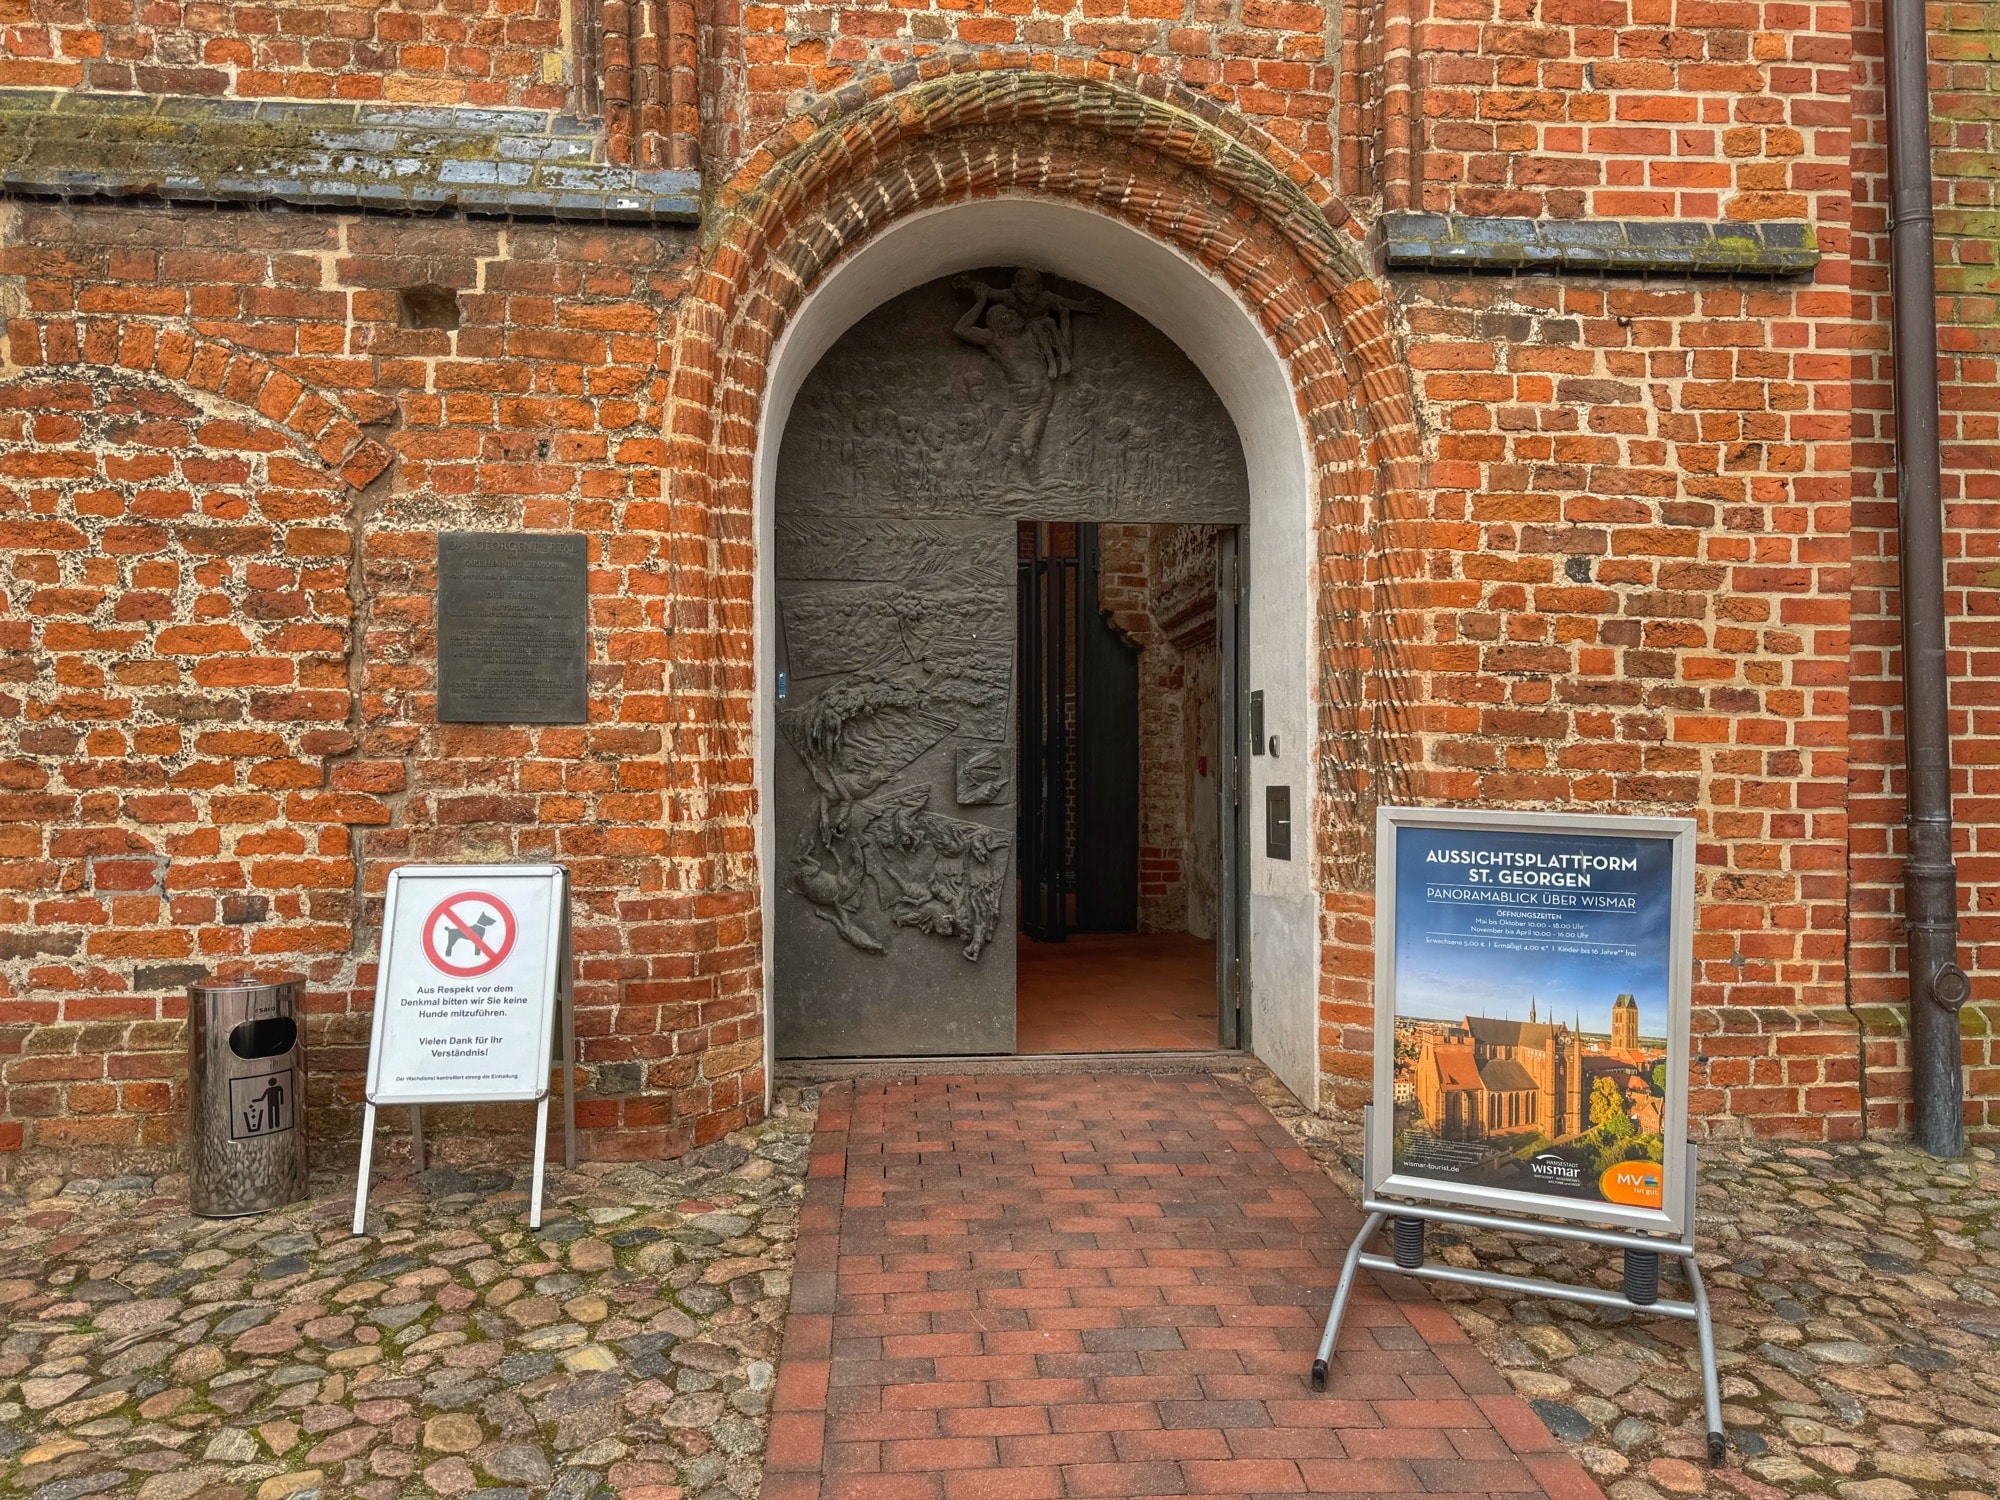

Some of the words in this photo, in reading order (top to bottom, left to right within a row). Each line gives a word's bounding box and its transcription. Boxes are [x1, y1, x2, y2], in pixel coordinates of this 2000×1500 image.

[447, 540, 470, 551] DAS
[476, 540, 577, 554] GEORGENPORTAL
[485, 560, 523, 569] HENNING
[1425, 849, 1637, 872] AUSSICHTSPLATTFORM
[1468, 868, 1493, 883] ST.
[1498, 869, 1591, 888] GEORGEN
[1427, 887, 1538, 904] PANORAMABLICK
[1542, 891, 1577, 906] ÜBER
[1581, 896, 1636, 909] WISMAR
[1496, 909, 1562, 920] ÖFFNUNGSZEITEN
[1475, 917, 1487, 925] Mai
[1499, 919, 1526, 927] Oktober
[1552, 922, 1571, 930] 18.00
[1470, 925, 1503, 934] November
[1516, 929, 1531, 937] April
[1425, 936, 1462, 946] Erwachsene
[1493, 941, 1522, 951] Ermäßigt
[1557, 945, 1579, 953] Kinder
[1580, 947, 1590, 955] bis
[416, 986, 435, 994] Aus
[437, 985, 474, 995] Respekt
[493, 985, 514, 993] dem
[400, 998, 440, 1007] Denkmal
[442, 998, 468, 1006] bitten
[487, 997, 502, 1005] Sie
[503, 996, 528, 1004] keine
[418, 1009, 448, 1018] Hunde
[450, 1009, 507, 1018] mitzuführen.
[418, 1037, 447, 1046] Vielen
[449, 1036, 473, 1045] Dank
[475, 1036, 489, 1045] für
[490, 1035, 503, 1044] Ihr
[431, 1048, 489, 1058] Verständnis!
[1403, 1161, 1460, 1172] wismar-tourist.de
[1546, 1159, 1579, 1168] HANSESTADT
[1617, 1173, 1643, 1186] MV
